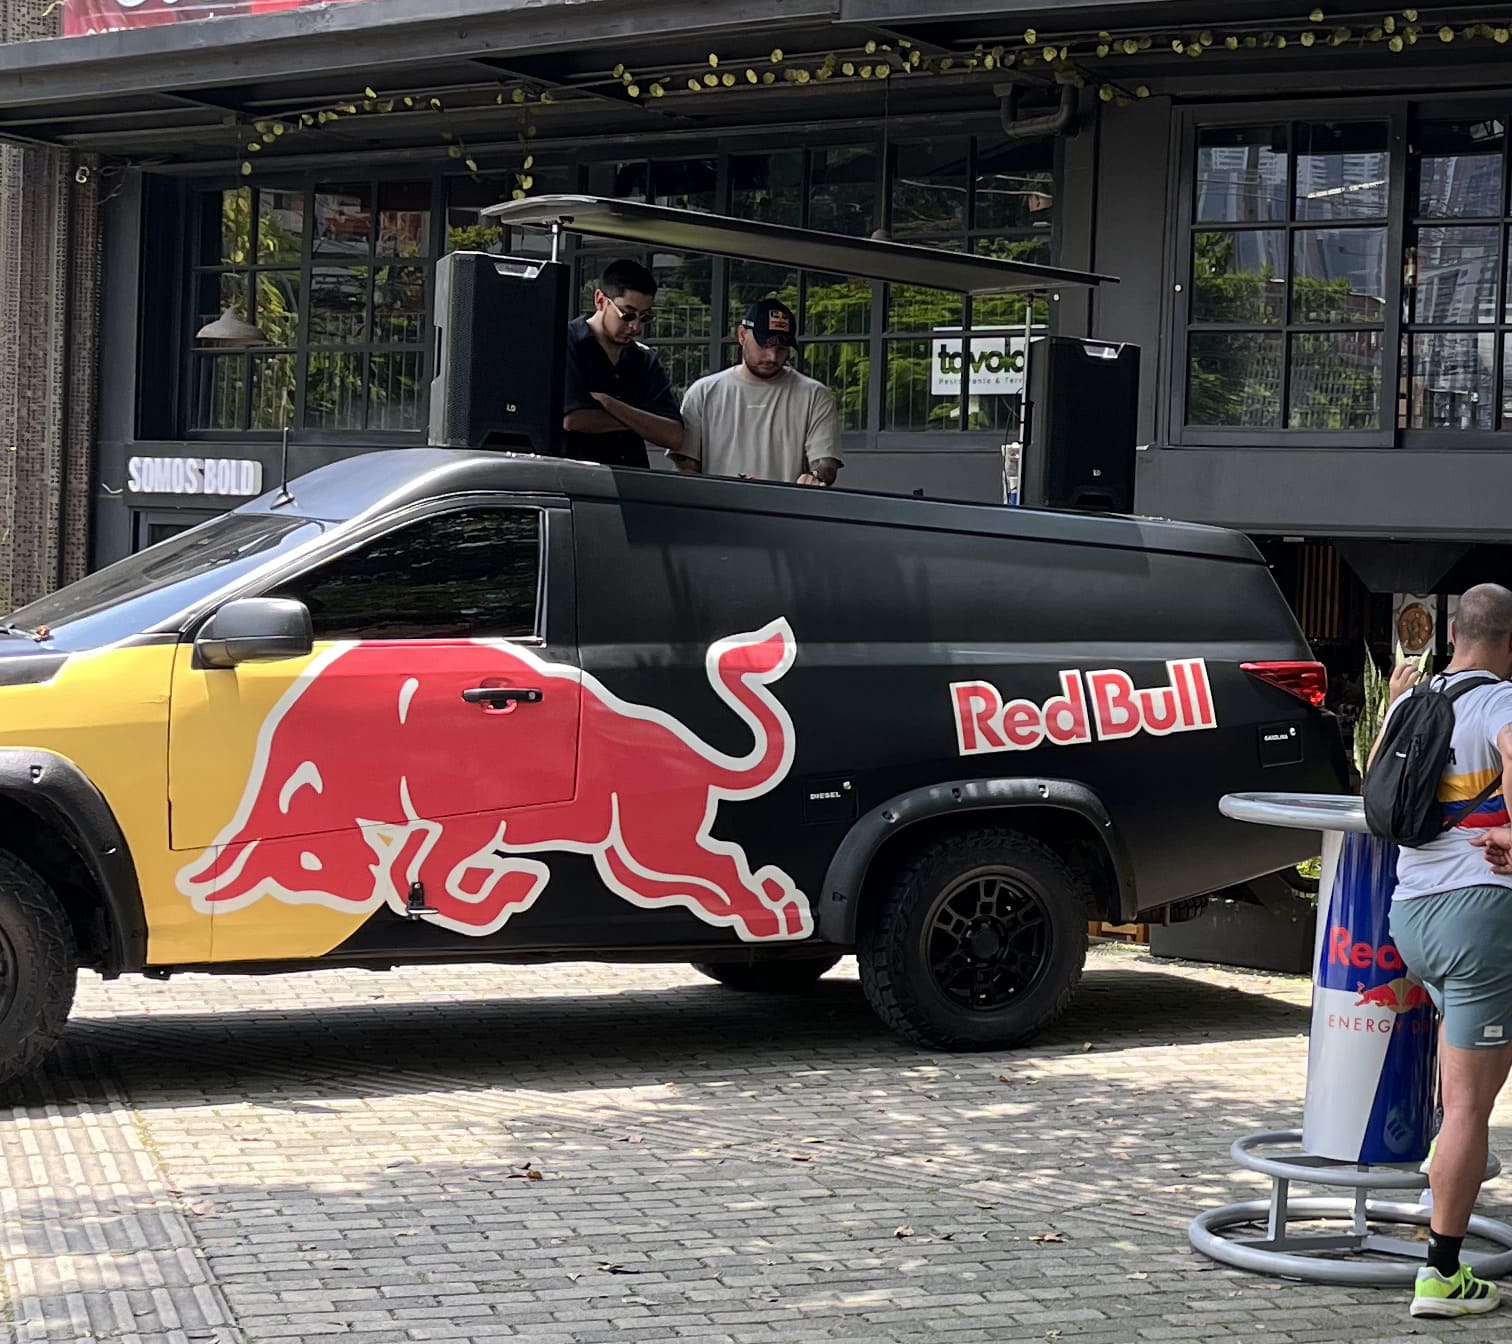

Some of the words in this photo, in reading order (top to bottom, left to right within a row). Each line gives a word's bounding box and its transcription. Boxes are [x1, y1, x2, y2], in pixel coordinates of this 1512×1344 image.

[128, 456, 199, 494] SOMOS
[203, 458, 257, 496] BOLD
[952, 671, 1089, 753] Red
[1090, 660, 1215, 738] Bull
